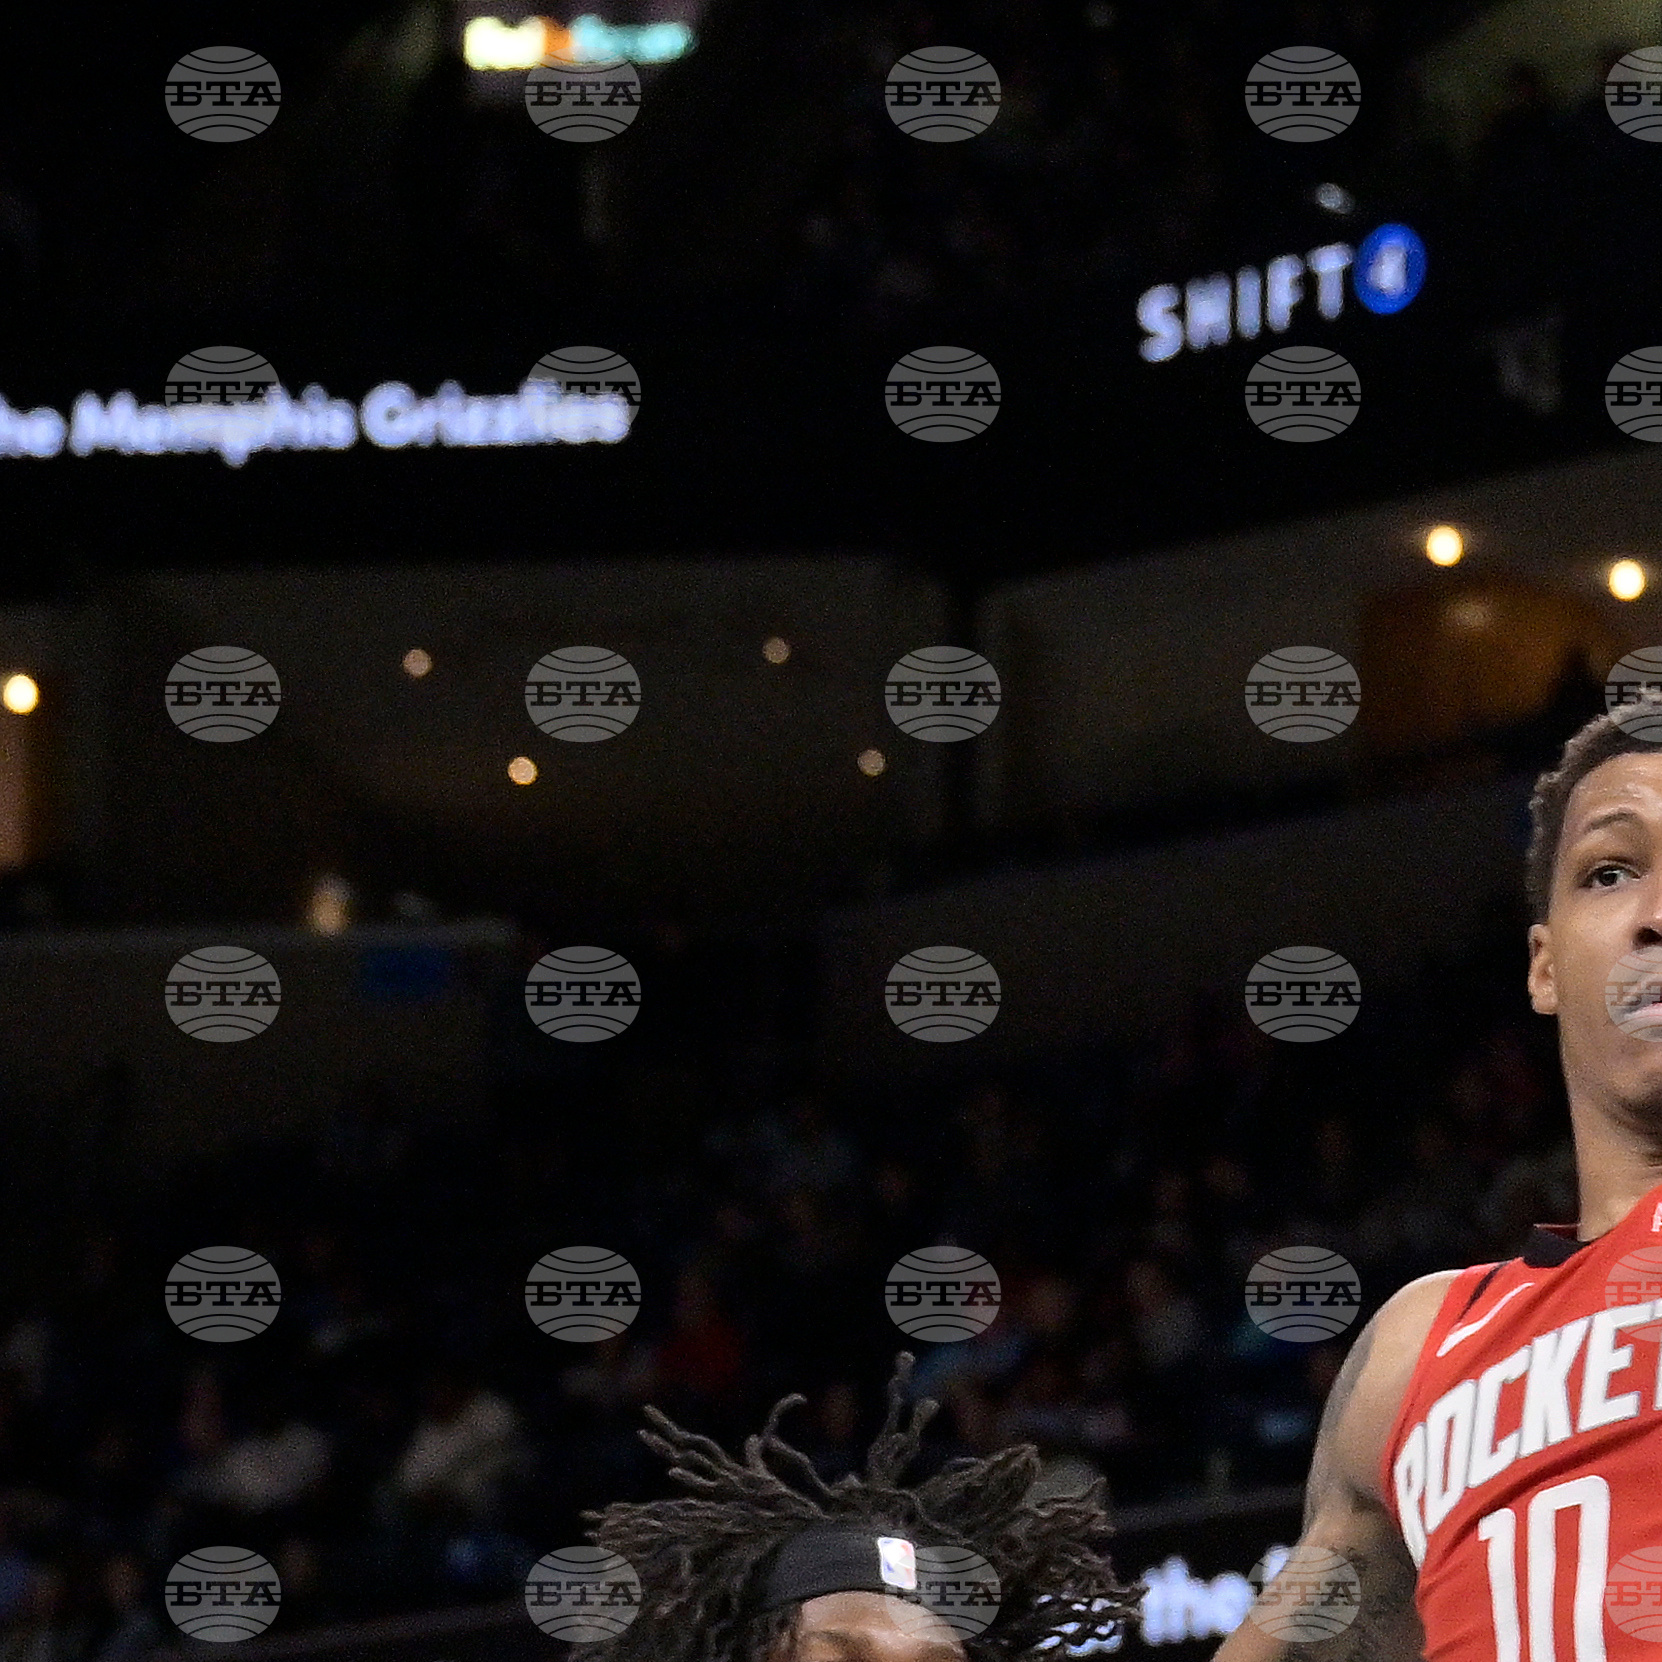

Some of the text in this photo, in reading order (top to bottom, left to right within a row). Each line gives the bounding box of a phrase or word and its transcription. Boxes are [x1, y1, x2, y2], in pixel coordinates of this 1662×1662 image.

[1136, 243, 1353, 363] SHIFT
[69, 388, 356, 468] Memphis
[361, 378, 630, 449] Grizzlies
